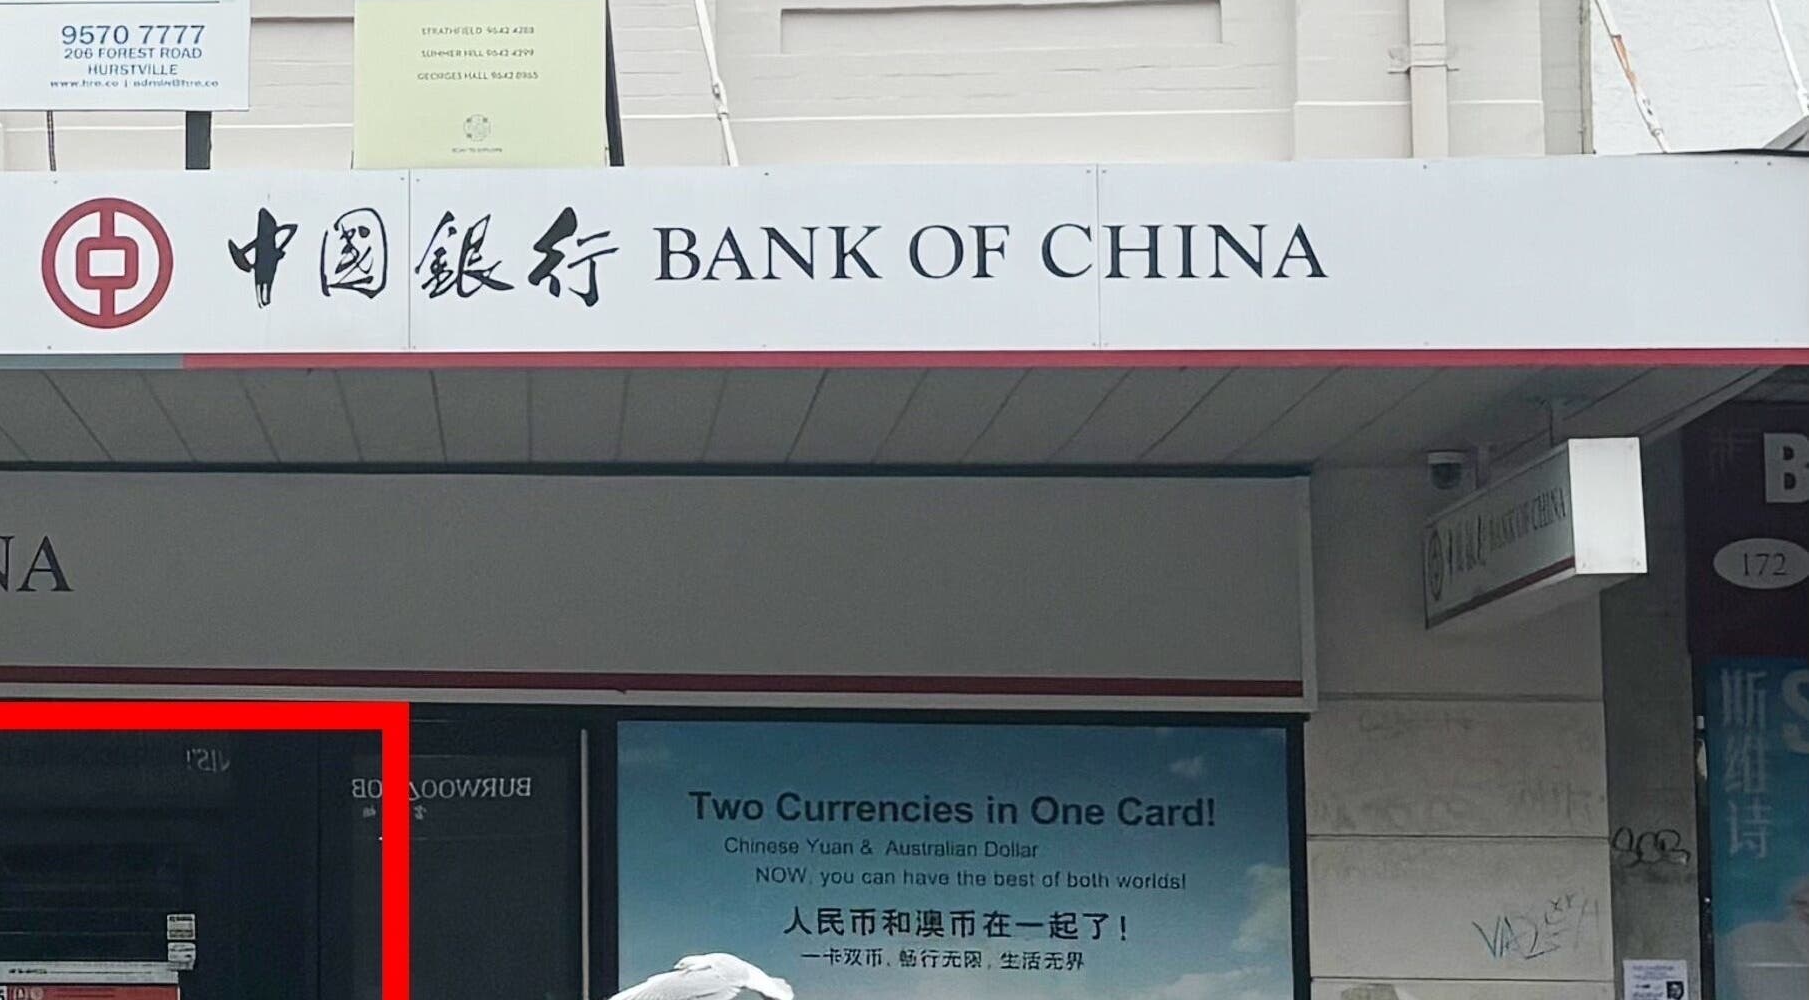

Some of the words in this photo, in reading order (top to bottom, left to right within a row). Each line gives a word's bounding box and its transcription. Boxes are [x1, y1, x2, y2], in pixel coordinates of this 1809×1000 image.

[61, 25, 129, 45] 9570
[138, 25, 206, 45] 7777
[64, 47, 94, 59] 206
[97, 47, 156, 59] FOREST
[160, 47, 203, 59] ROAD
[87, 63, 178, 76] HURSTVILLE
[652, 224, 883, 281] BANK
[908, 223, 1011, 280] OF
[1040, 222, 1329, 280] CHINA
[1743, 552, 1790, 577] 172
[689, 791, 764, 821] Two
[776, 791, 974, 823] Currencies
[986, 795, 1018, 825] in
[1030, 796, 1105, 826] One
[1117, 796, 1216, 827] Card!
[724, 837, 799, 855] Chinese
[806, 838, 855, 856] Yuan
[860, 839, 873, 856] &
[884, 840, 978, 858] Australian
[984, 840, 1039, 858] Dollar
[820, 871, 855, 888] you
[860, 871, 896, 885] can
[902, 869, 950, 886] have
[957, 871, 987, 887] the
[993, 871, 1035, 888] best
[1041, 871, 1060, 888] of
[1066, 871, 1110, 888] both
[1115, 872, 1187, 890] worlds!
